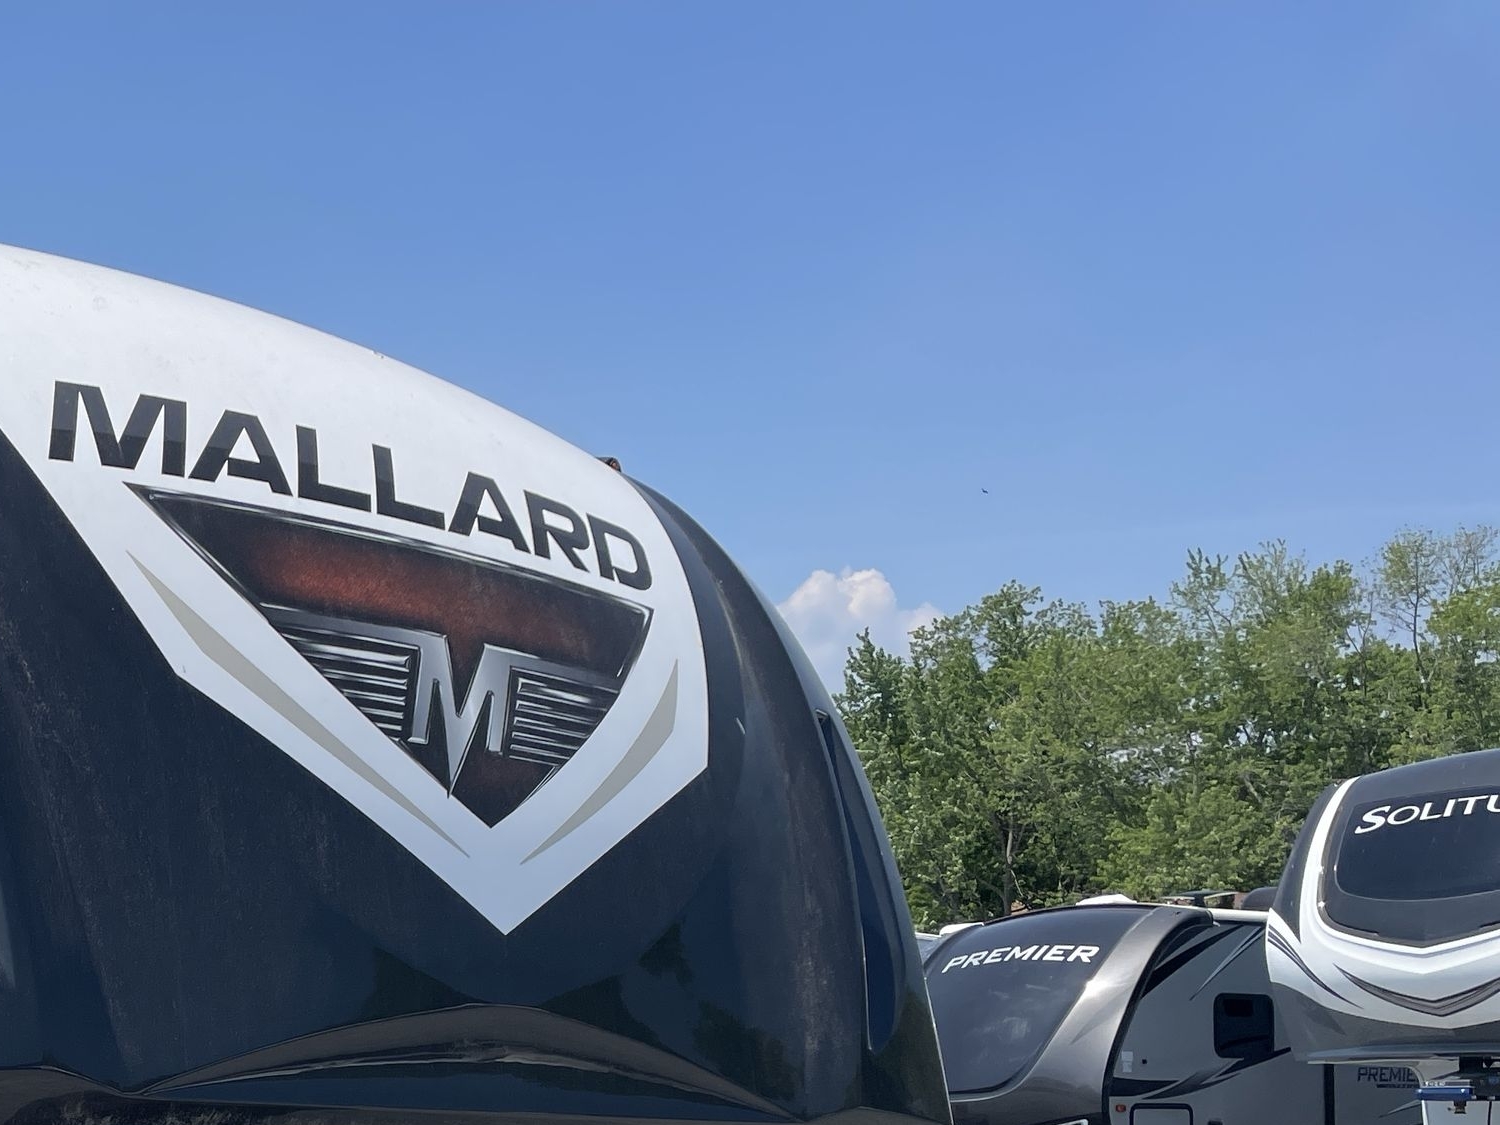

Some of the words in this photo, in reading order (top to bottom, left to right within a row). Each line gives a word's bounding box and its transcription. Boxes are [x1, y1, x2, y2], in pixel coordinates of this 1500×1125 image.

[48, 380, 652, 591] MALLARD
[941, 944, 1100, 974] PREMIER
[1357, 1066, 1420, 1082] PREMIE
